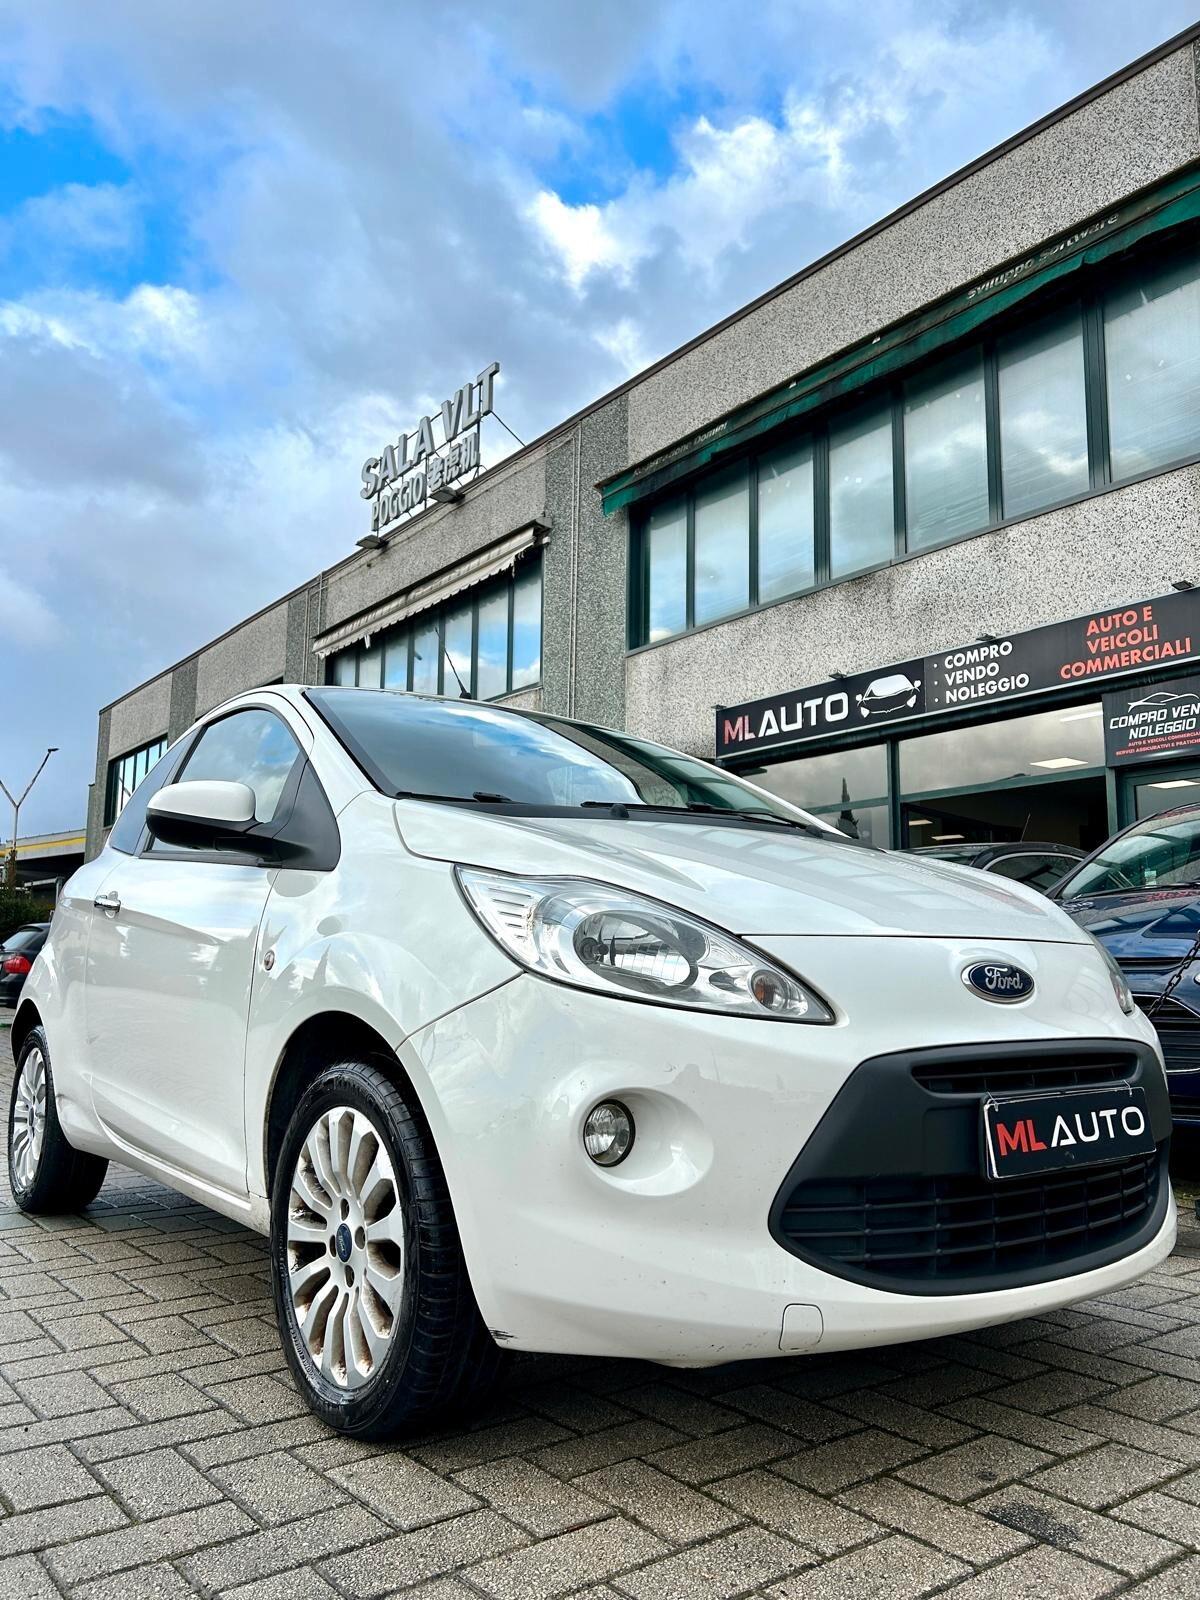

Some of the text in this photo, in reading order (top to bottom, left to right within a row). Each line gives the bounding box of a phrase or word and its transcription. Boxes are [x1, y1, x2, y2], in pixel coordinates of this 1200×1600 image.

[360, 362, 500, 499] SALA VLT
[371, 432, 480, 532] POGGIO 老虎机
[1086, 605, 1153, 637] AUTO E
[1086, 624, 1158, 655] VEICOLI
[944, 641, 1013, 669] COMPRO
[1060, 637, 1191, 679] COMMERCIALI
[944, 662, 1000, 687] VENDO
[945, 673, 1030, 704] NOLEGGIO
[1110, 709, 1167, 729] COMPRO
[1129, 718, 1196, 739] NOLEGGIO
[1147, 736, 1168, 744] VEICOLI
[984, 966, 1023, 990] Ford
